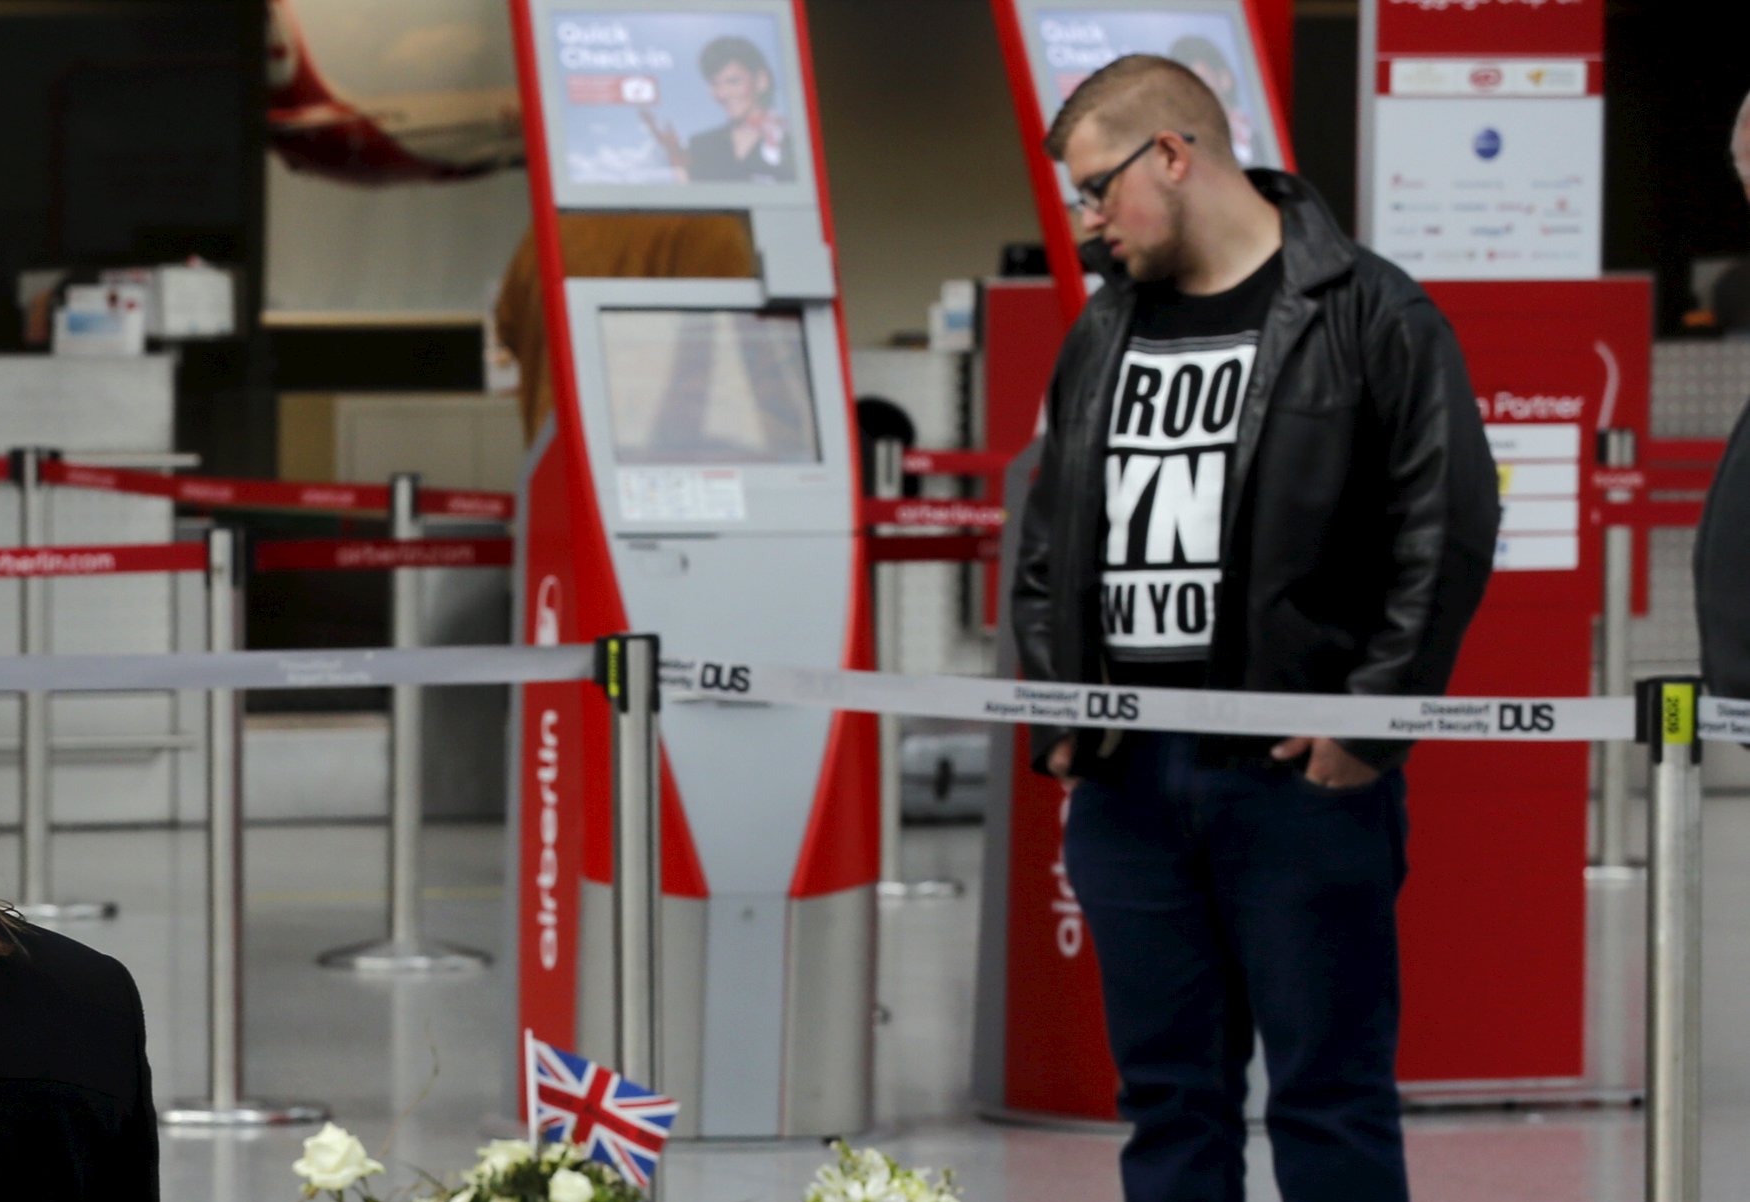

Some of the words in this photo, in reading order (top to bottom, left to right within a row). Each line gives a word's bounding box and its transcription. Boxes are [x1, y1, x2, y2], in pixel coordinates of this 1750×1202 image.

[700, 661, 751, 693] DUS
[1086, 690, 1140, 721] DUS
[1498, 702, 1555, 732] DUS
[1388, 718, 1434, 735] Airport
[1440, 718, 1490, 735] Security
[536, 708, 560, 971] airberlin
